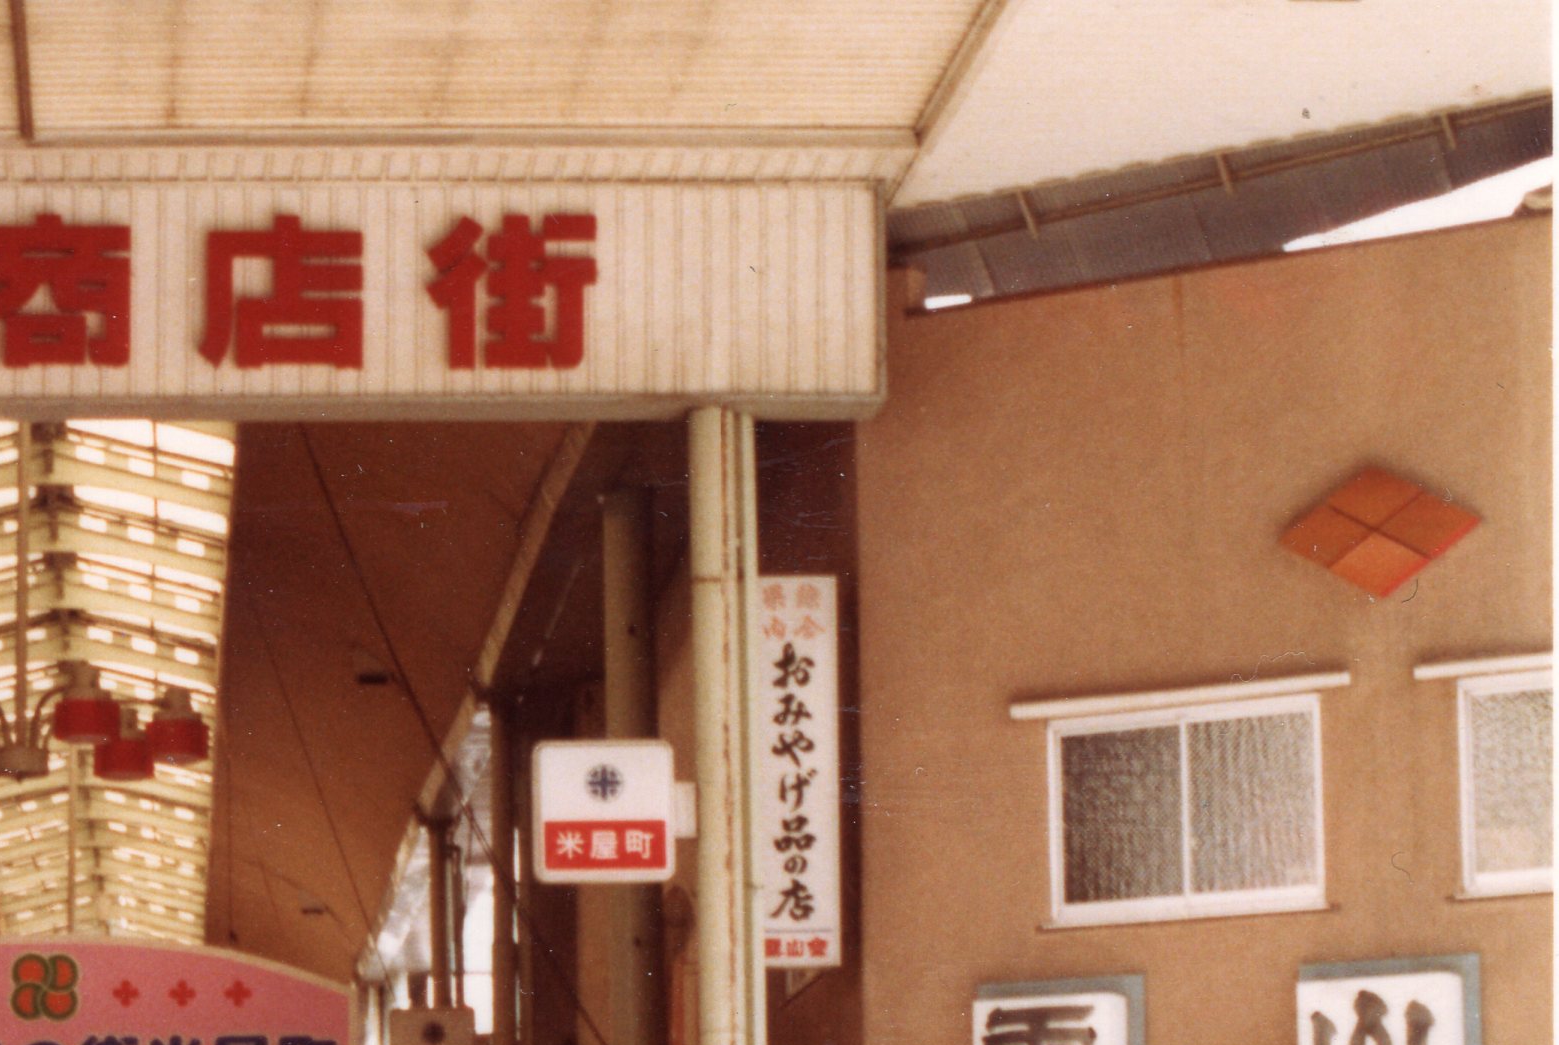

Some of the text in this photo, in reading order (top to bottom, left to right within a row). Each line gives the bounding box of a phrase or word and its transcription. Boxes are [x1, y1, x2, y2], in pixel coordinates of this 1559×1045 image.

[555, 828, 656, 862] 米屋町
[770, 641, 819, 921] おみやげ品の店
